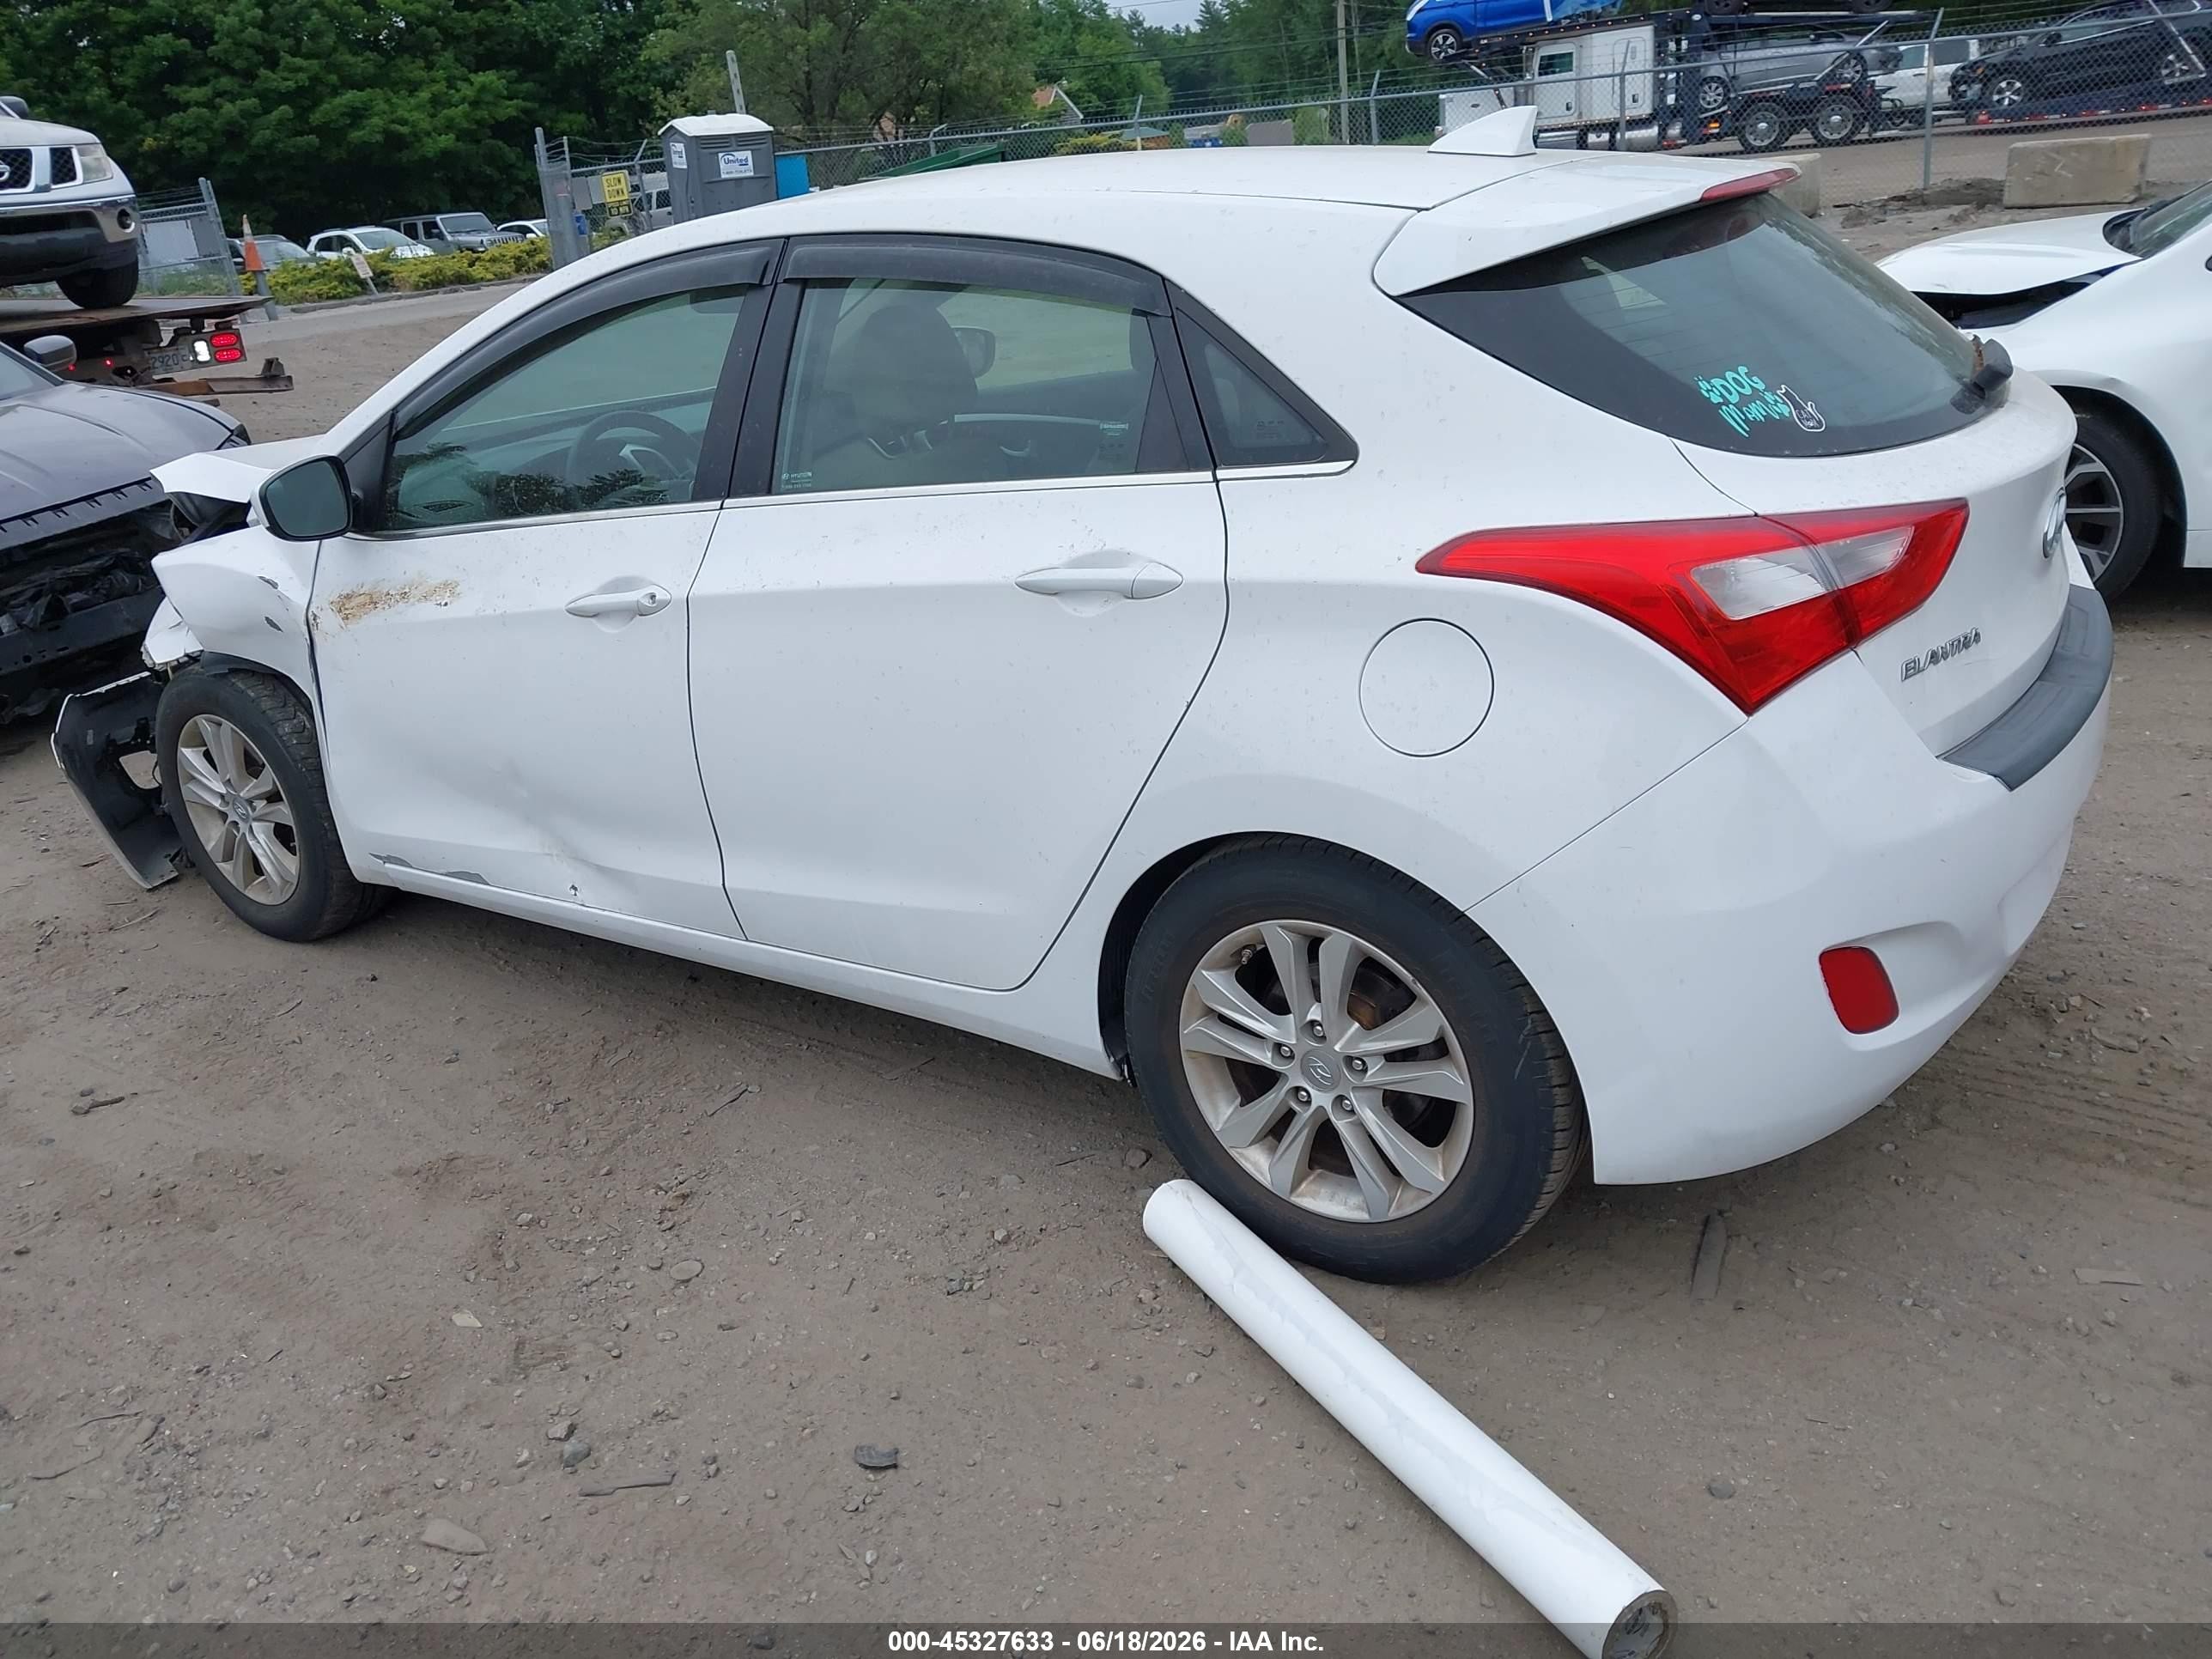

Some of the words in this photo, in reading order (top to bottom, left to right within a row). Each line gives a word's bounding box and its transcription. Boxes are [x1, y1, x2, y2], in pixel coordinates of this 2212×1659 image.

[723, 156, 749, 165] United
[605, 177, 622, 187] SLOW
[607, 188, 625, 199] DOWN
[1900, 626, 1981, 682] ELANTRA
